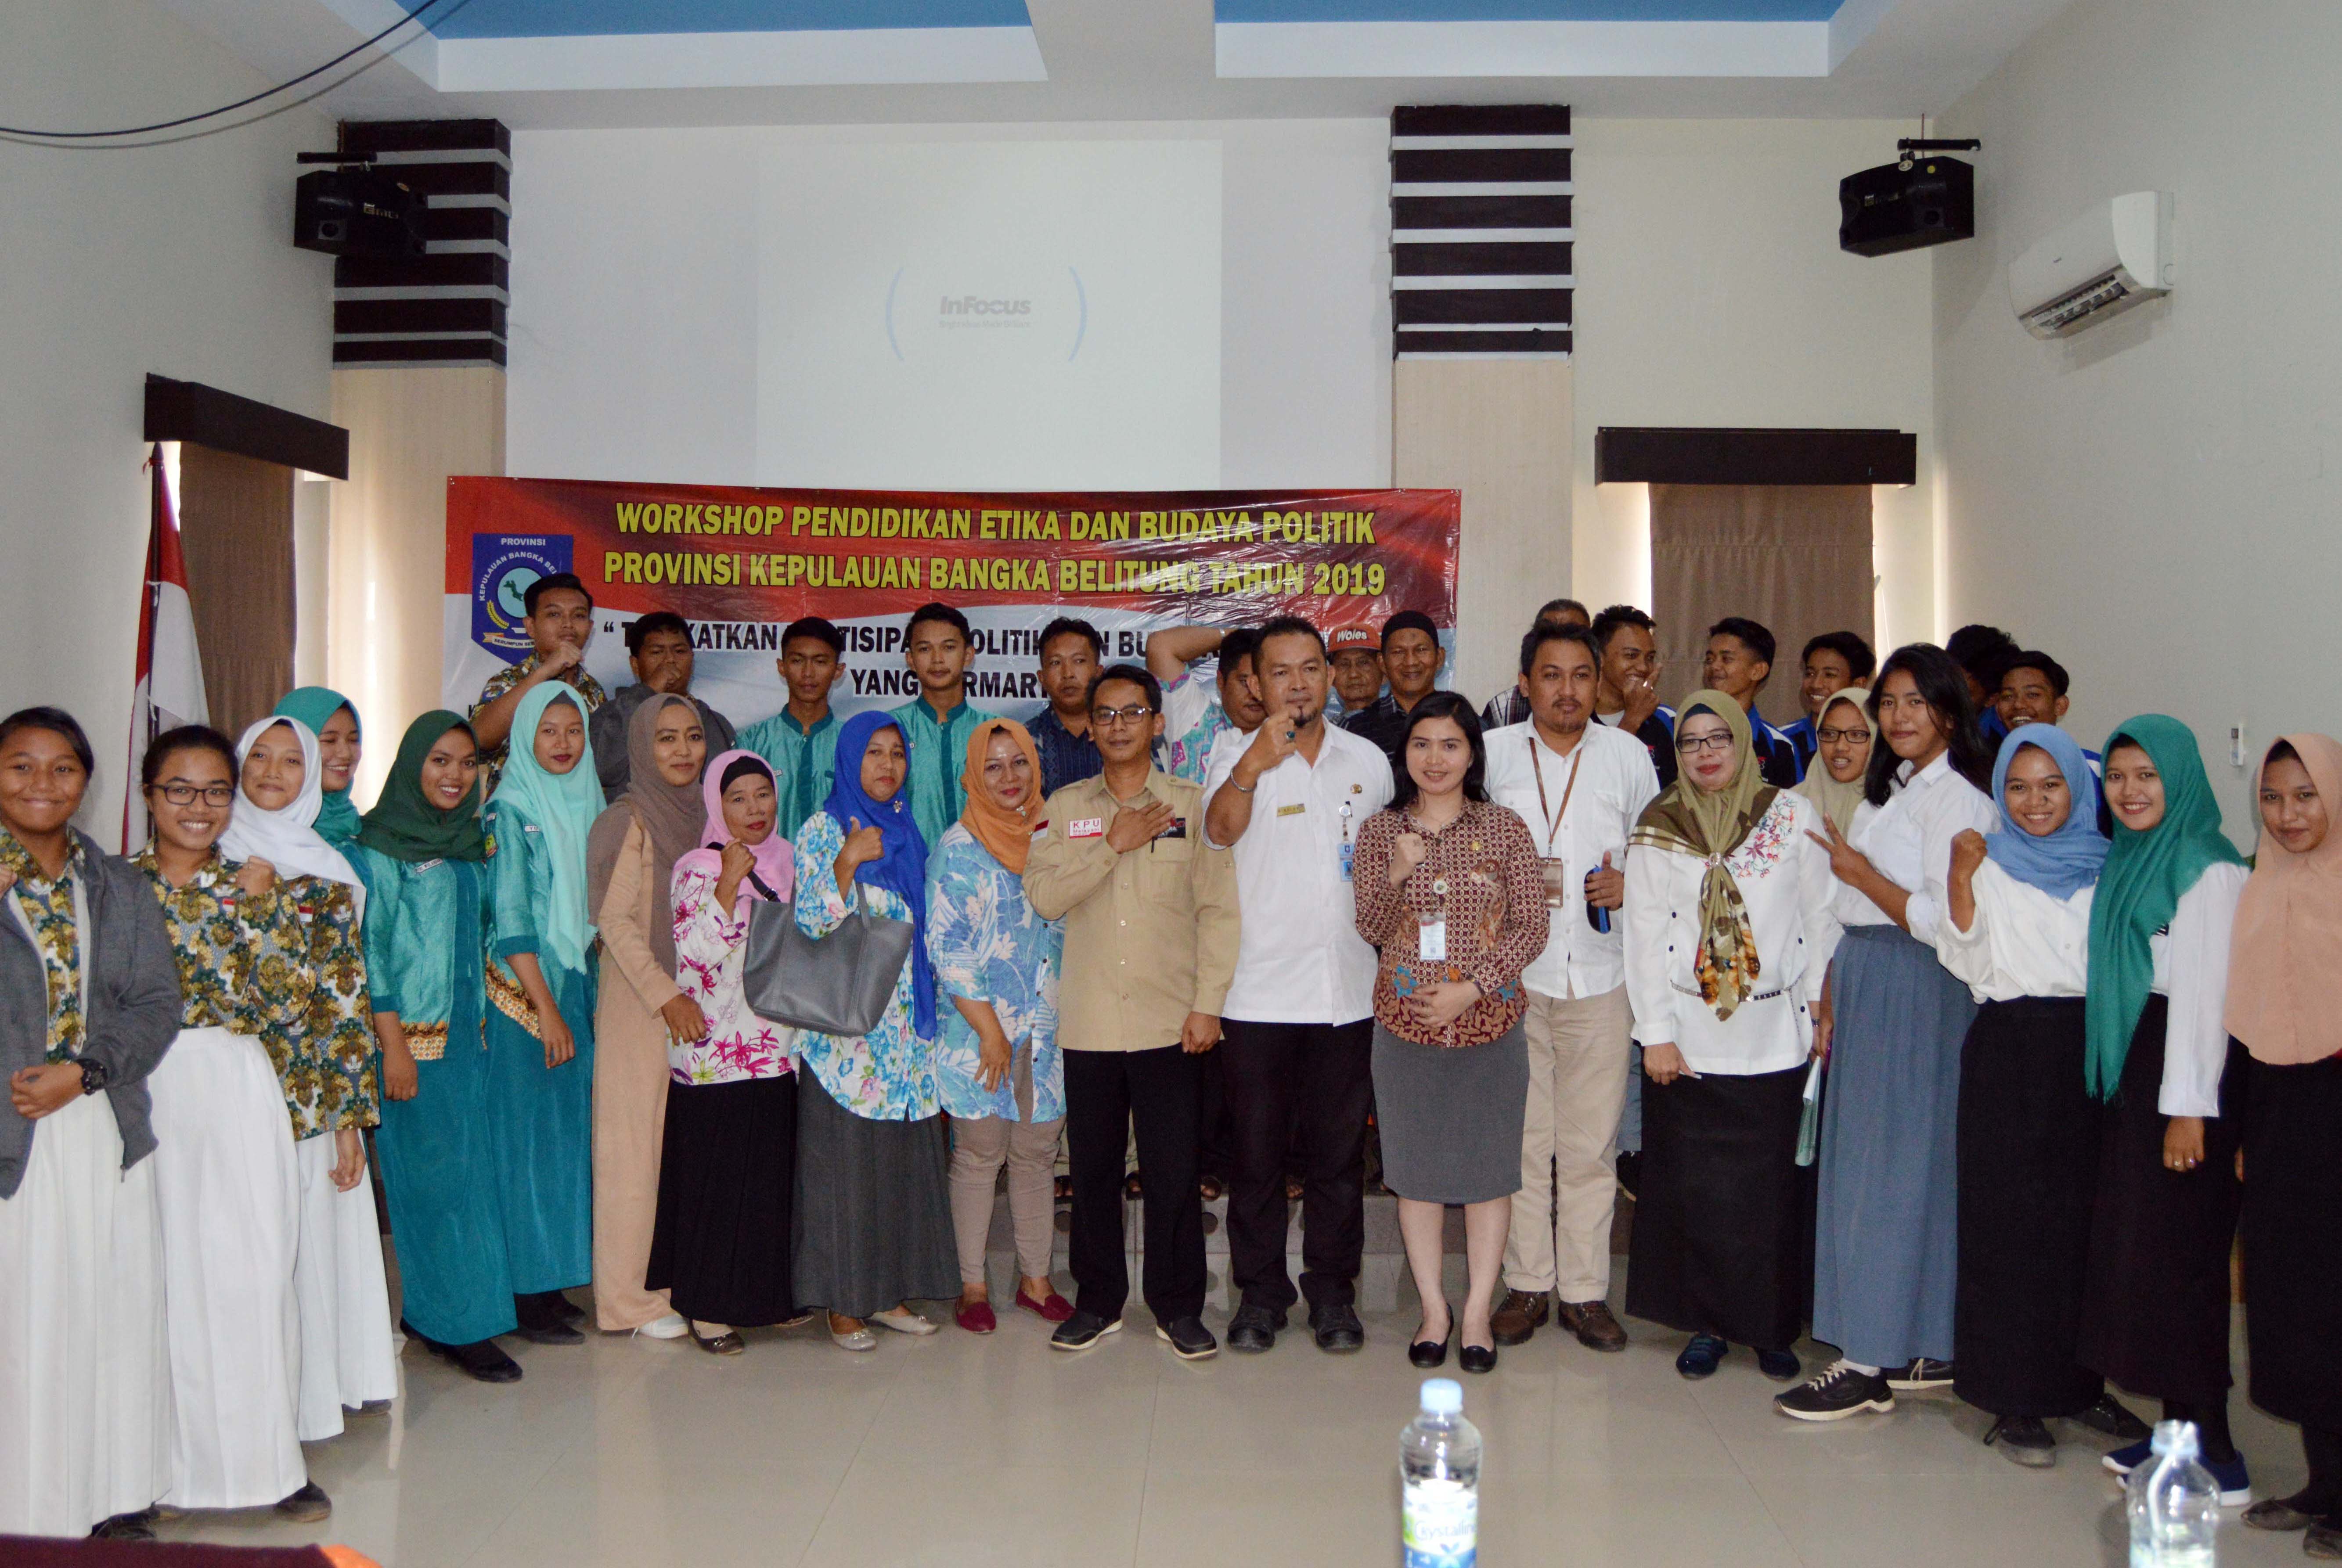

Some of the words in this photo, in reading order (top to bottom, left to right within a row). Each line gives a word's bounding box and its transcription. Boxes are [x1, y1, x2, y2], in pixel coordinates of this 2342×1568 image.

[940, 295, 1031, 315] InFocus
[616, 502, 785, 536] WORKSHOP
[791, 506, 971, 539] PENDIDIKAN
[980, 510, 1061, 540] ETIKA
[1070, 511, 1130, 541] DAN
[1139, 511, 1254, 543] BUDAYA
[1262, 511, 1376, 544] POLITIK
[501, 538, 546, 546] PROVINSI
[479, 556, 507, 601] KEPULAUAN
[508, 551, 544, 564] BANGKA
[605, 552, 741, 585] PROVINSI
[749, 554, 921, 589] KEPULAUAN
[930, 557, 1051, 590] BANGKA
[1059, 560, 1200, 593] BELITUNG
[1208, 561, 1304, 595] TAHUN
[1313, 563, 1386, 596] 2019
[1337, 629, 1367, 643] Woles
[850, 669, 919, 696] YANG
[1074, 820, 1099, 828] KPU
